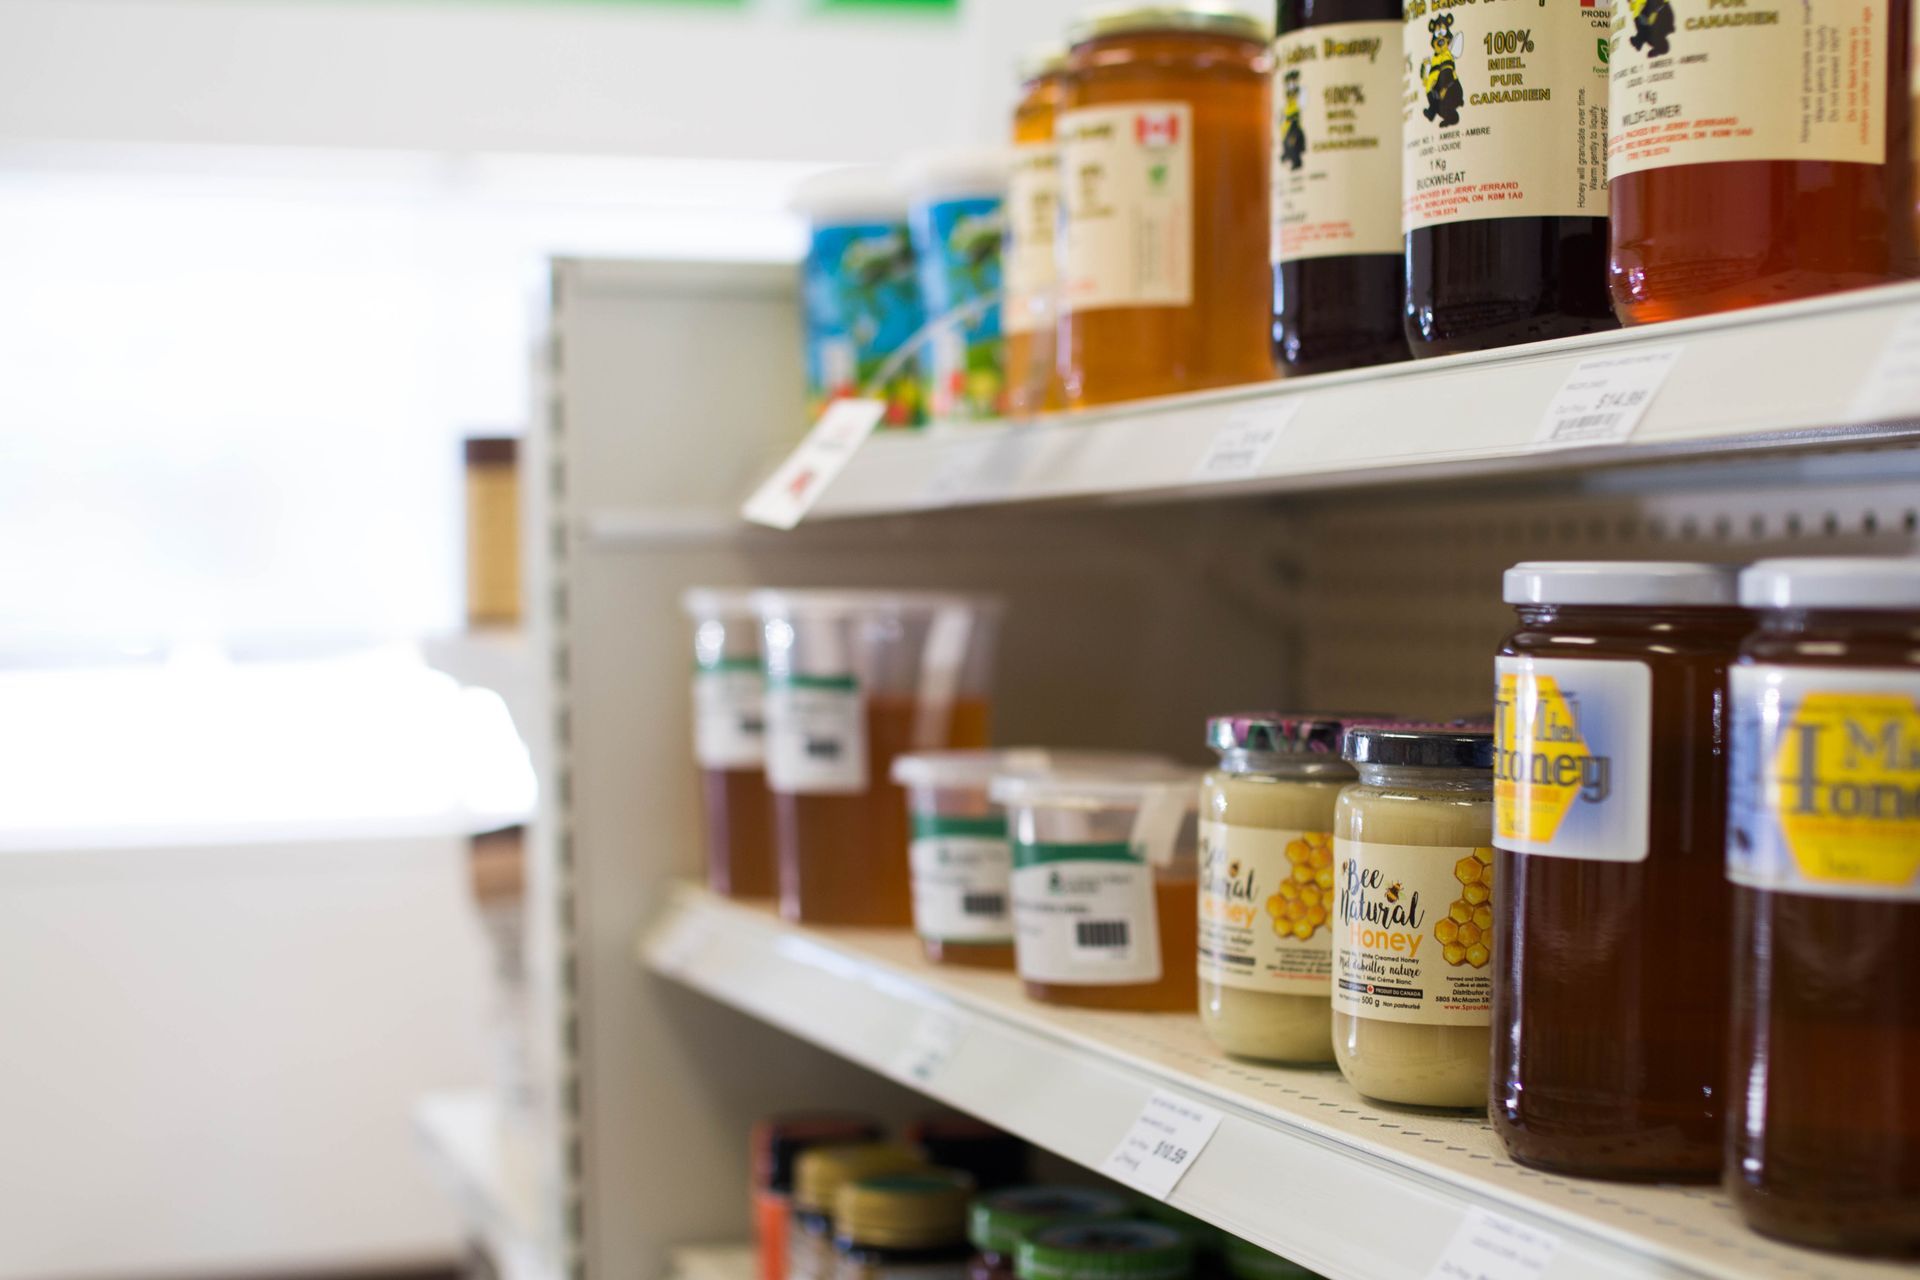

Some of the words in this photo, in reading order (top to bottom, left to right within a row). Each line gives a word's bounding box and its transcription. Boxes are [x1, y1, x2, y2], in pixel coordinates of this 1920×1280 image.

[1685, 11, 1779, 31] CANADIEN
[1484, 29, 1535, 55] 100%
[1487, 57, 1526, 71] MIEL
[1490, 73, 1523, 87] PUR
[1470, 88, 1551, 105] CANADIEN
[1578, 108, 1586, 126] over
[1622, 104, 1683, 127] WILDFLOWER
[1465, 126, 1491, 137] AMBRE
[1590, 131, 1597, 140] to
[1577, 128, 1587, 166] granulate
[1589, 141, 1599, 165] gently
[1577, 167, 1585, 180] will
[1589, 168, 1598, 191] Warm
[1454, 185, 1478, 195] JERRY
[1478, 181, 1519, 192] JERRARD
[1577, 182, 1587, 208] Honey
[1472, 193, 1484, 203] ON
[1348, 857, 1384, 896] Bee
[1340, 887, 1425, 930] Natural
[1350, 921, 1423, 958] Honey
[1375, 954, 1400, 963] Creamed
[1400, 957, 1420, 965] Honey
[1389, 964, 1422, 979] nature
[1361, 996, 1373, 1005] 500
[1375, 999, 1380, 1008] g
[1400, 990, 1422, 998] CANADA
